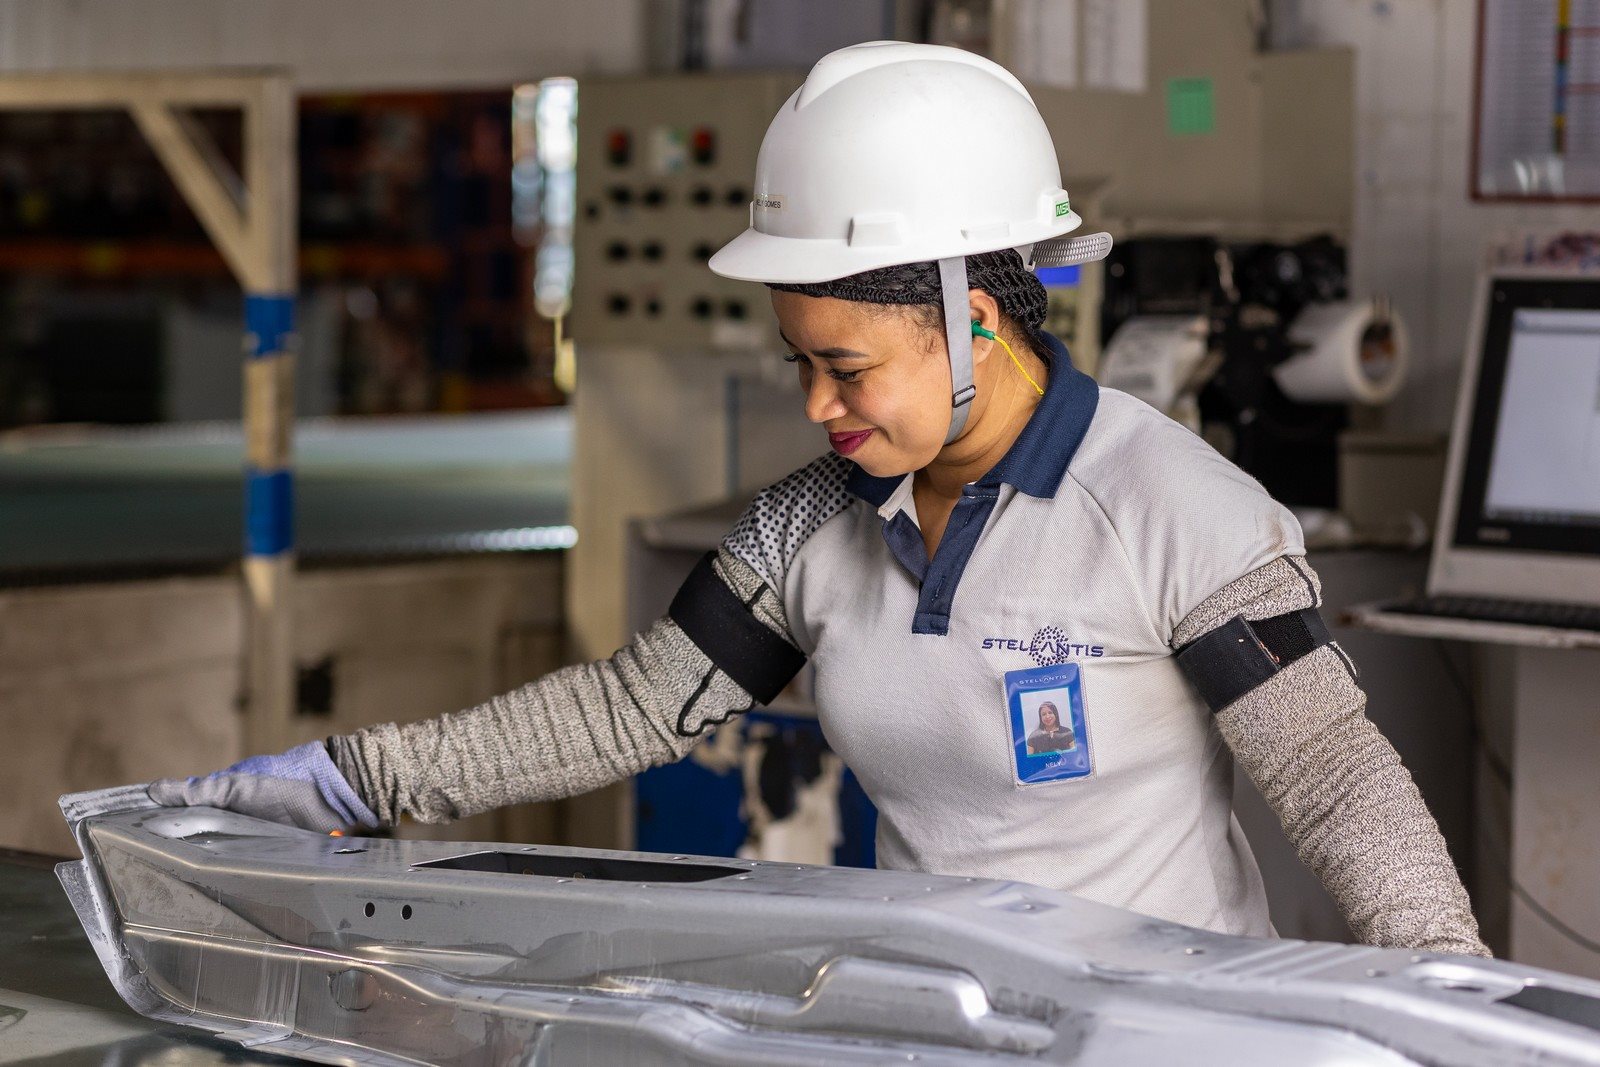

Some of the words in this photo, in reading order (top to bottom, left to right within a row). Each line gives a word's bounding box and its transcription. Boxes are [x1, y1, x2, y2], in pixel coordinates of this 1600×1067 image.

[764, 200, 781, 209] GOMES
[981, 638, 1104, 658] STELLANTIS
[1018, 674, 1067, 685] STELLANTIS
